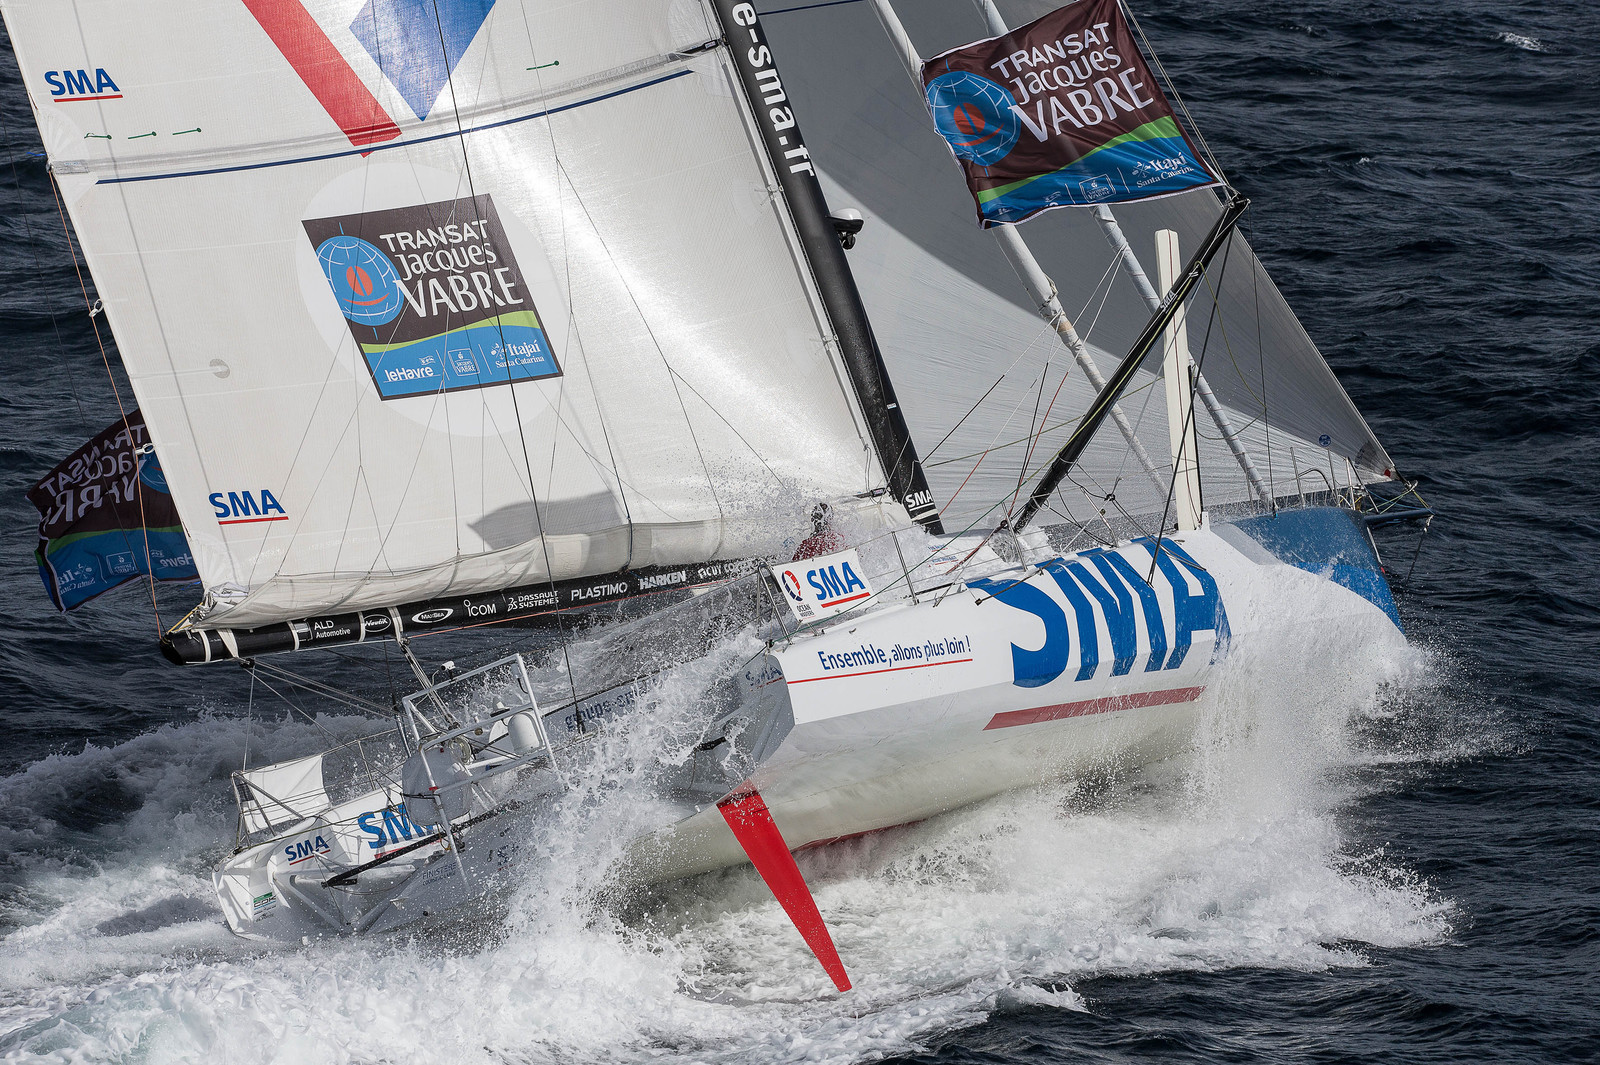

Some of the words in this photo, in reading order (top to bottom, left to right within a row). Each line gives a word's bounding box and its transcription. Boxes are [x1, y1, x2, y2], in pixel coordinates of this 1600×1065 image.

[990, 21, 1111, 79] TRANSAT
[44, 67, 121, 96] SMA
[1007, 66, 1154, 143] VABRE
[1136, 176, 1161, 189] Santa
[379, 219, 488, 253] TRANSAT
[392, 266, 524, 318] VABRE
[495, 358, 515, 368] Santa
[515, 354, 545, 366] Catarina
[208, 489, 286, 518] SMA
[905, 489, 934, 508] SMA
[571, 582, 628, 601] PLASTIMO
[639, 570, 687, 590] HARKEN
[806, 561, 866, 600] SMA
[518, 590, 558, 602] DASSAULT
[964, 534, 1233, 689] SMA
[314, 620, 334, 630] ALD
[315, 628, 351, 639] Automotive
[891, 643, 923, 662] allons
[923, 639, 945, 661] plus
[943, 637, 965, 655] loin
[284, 835, 330, 861] SMA
